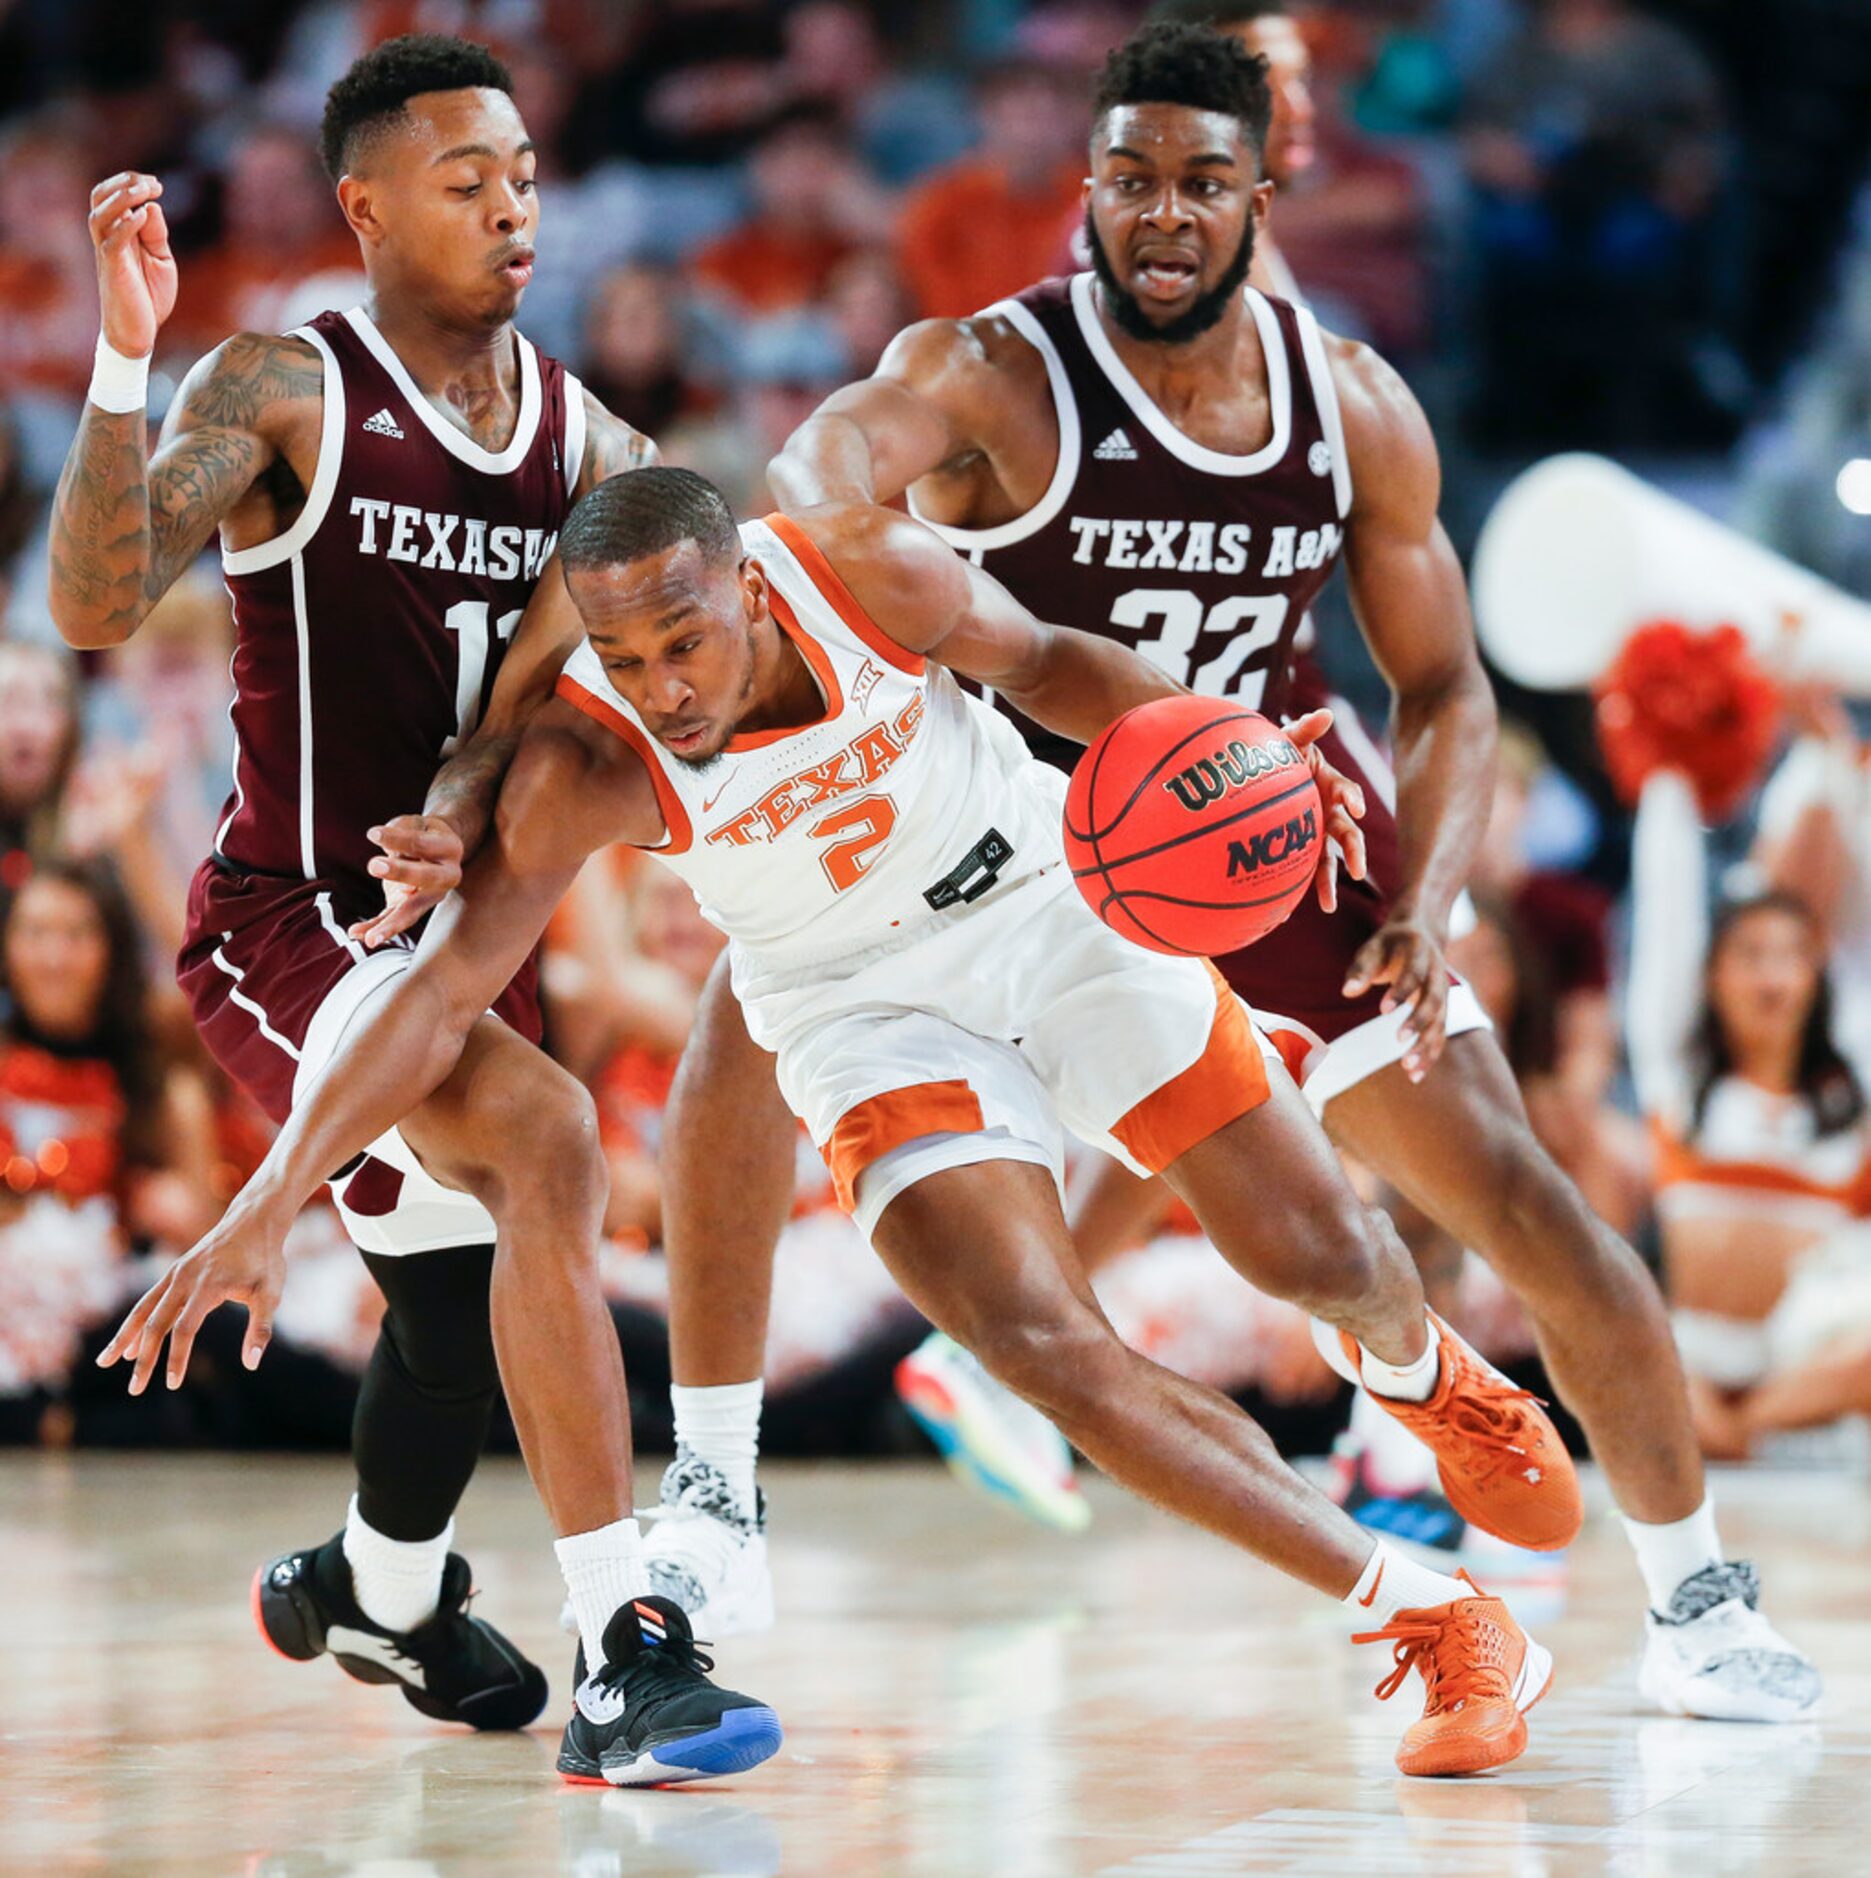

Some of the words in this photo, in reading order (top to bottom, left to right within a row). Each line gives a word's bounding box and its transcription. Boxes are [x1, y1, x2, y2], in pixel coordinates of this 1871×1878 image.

[362, 421, 404, 440] adidas
[1092, 448, 1138, 460] adidas
[350, 496, 522, 581] TEXAS
[1069, 516, 1252, 576] TEXAS
[1261, 522, 1344, 579] A&M
[1108, 588, 1290, 714] 32
[703, 685, 927, 847] TEXAS
[1162, 738, 1305, 812] Wilson
[806, 793, 900, 895] 2
[985, 841, 1003, 860] 42
[1226, 807, 1318, 878] NCAA
